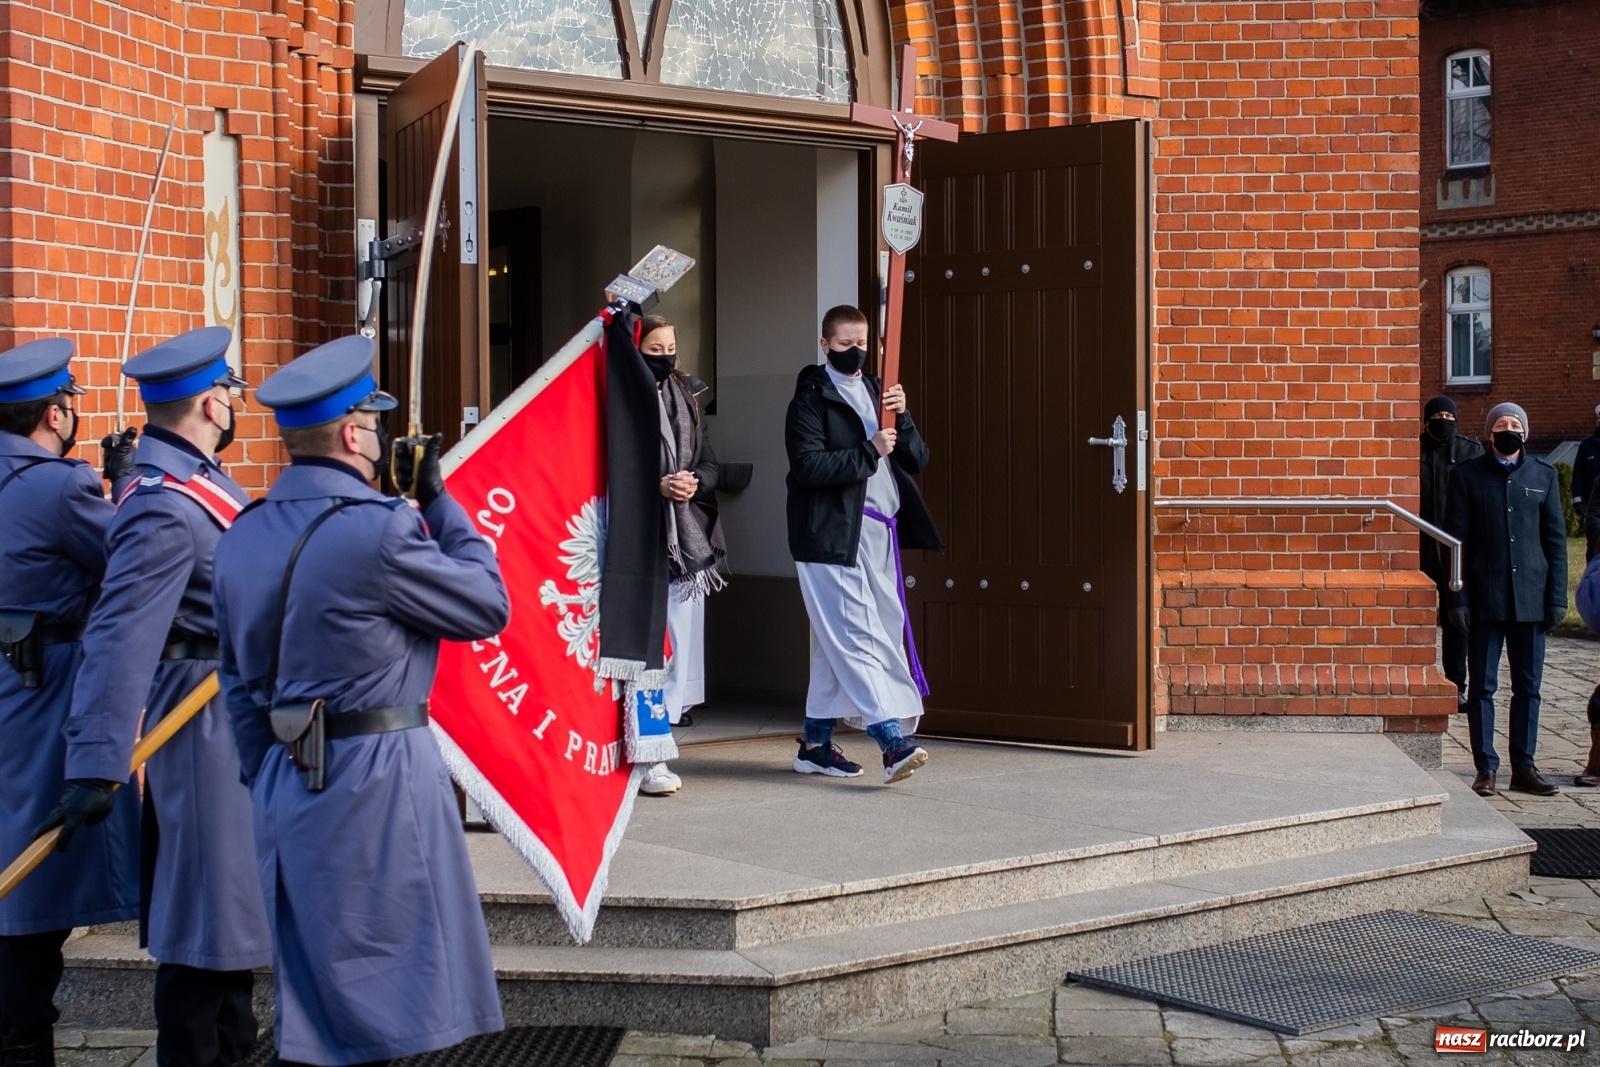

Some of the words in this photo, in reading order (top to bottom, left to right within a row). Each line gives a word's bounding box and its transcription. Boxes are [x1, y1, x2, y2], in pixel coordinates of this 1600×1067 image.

[892, 202, 912, 213] Kamil
[887, 211, 917, 226] Kwaśniak
[532, 708, 557, 741] I
[564, 729, 622, 777] PRAW
